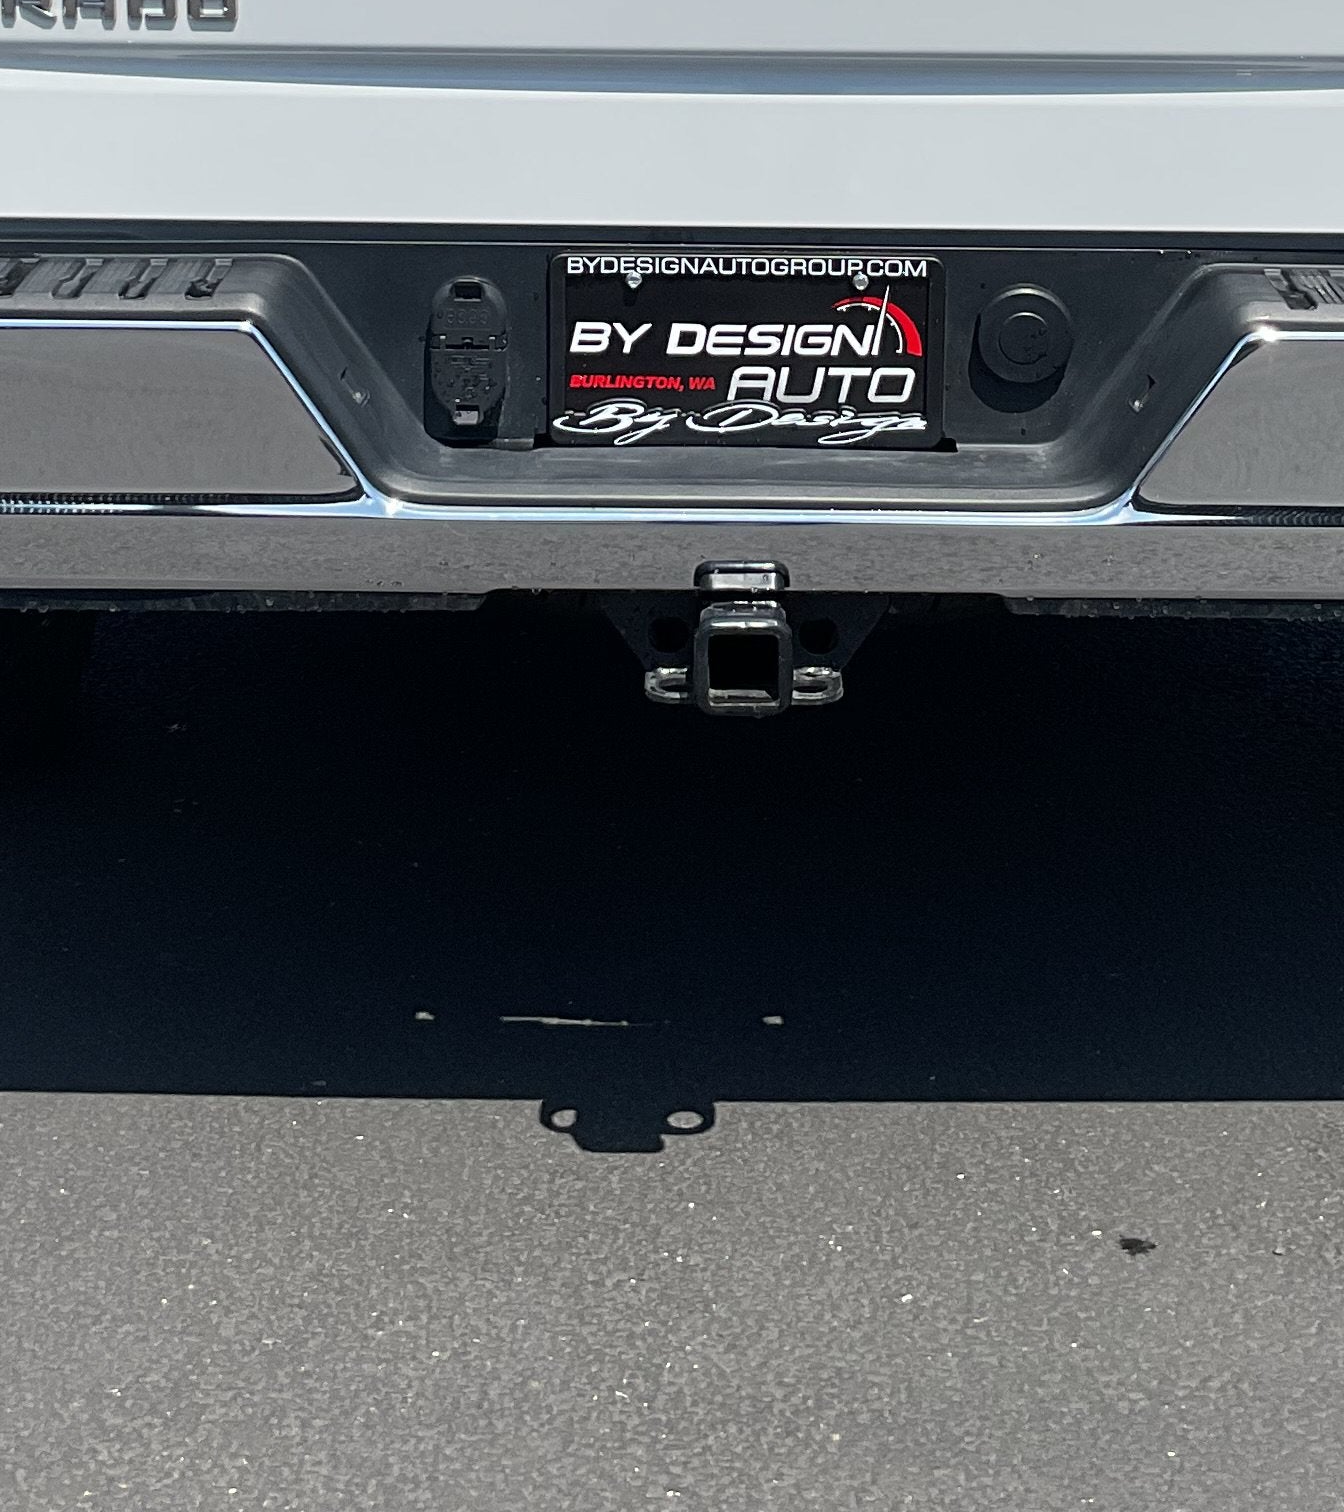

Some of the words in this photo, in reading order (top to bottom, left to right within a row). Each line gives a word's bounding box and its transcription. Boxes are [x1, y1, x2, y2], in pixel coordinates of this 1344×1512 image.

[566, 256, 928, 278] BYDESIGNAUTOGROUP.COM
[569, 320, 653, 354] BY
[665, 322, 886, 357] DESIGN
[568, 374, 684, 392] BURLINGTON,
[687, 376, 717, 391] WA
[725, 365, 917, 405] AUTO
[553, 399, 671, 446] By
[685, 399, 927, 445] Design
